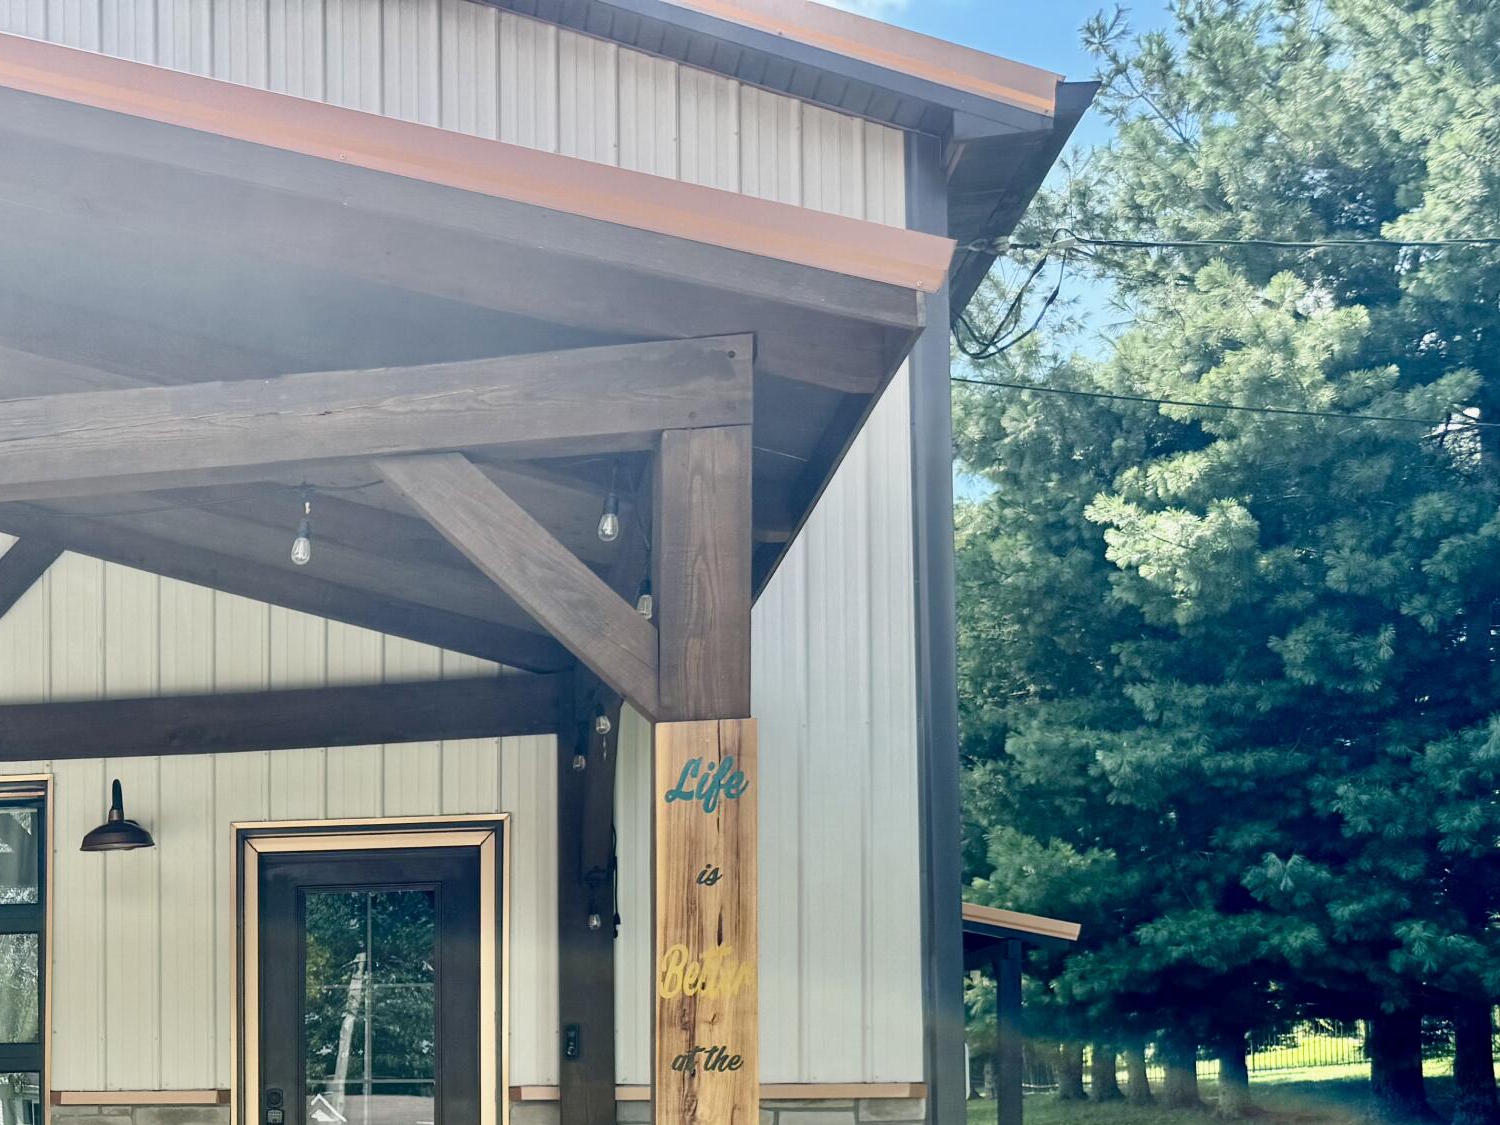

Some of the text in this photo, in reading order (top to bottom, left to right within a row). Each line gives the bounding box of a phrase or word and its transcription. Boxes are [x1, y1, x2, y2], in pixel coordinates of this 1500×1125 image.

[664, 755, 750, 814] Life
[696, 863, 723, 887] is
[659, 943, 757, 1001] Better
[671, 1045, 744, 1073] at the
